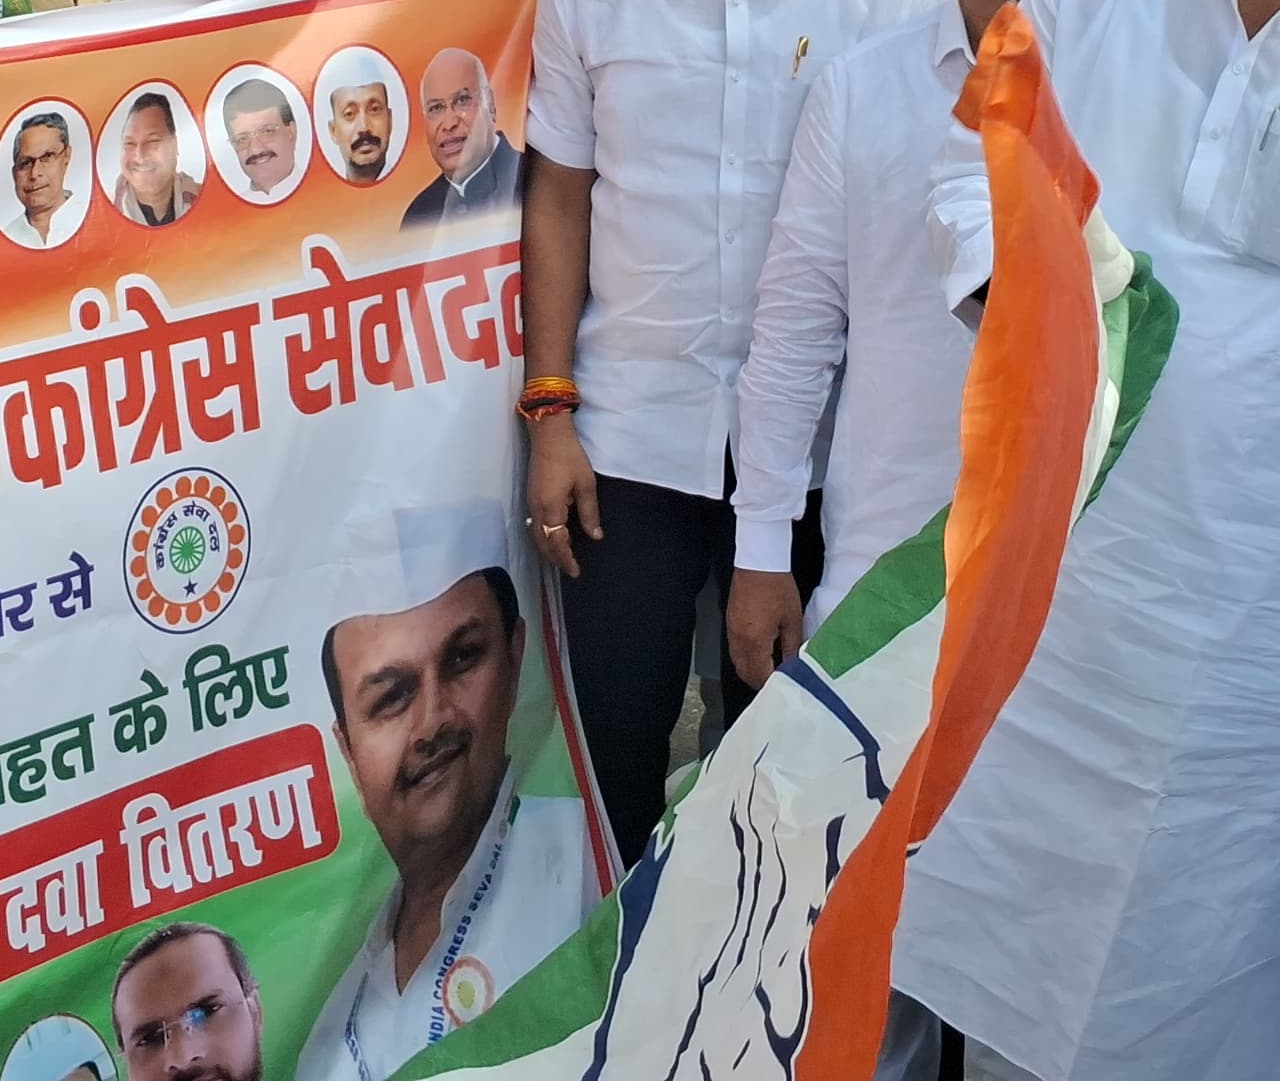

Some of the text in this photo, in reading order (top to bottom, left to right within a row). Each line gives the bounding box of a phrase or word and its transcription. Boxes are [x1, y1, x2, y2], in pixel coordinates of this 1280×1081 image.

[153, 500, 220, 570] कांग्रेस सेवा दल
[46, 551, 94, 619] से
[108, 669, 169, 754] के
[182, 643, 290, 733] लिए
[120, 764, 323, 909] वितरण
[468, 873, 493, 911] SEVA
[433, 915, 472, 1001] CONGRESS
[428, 1005, 445, 1046] NDIA
